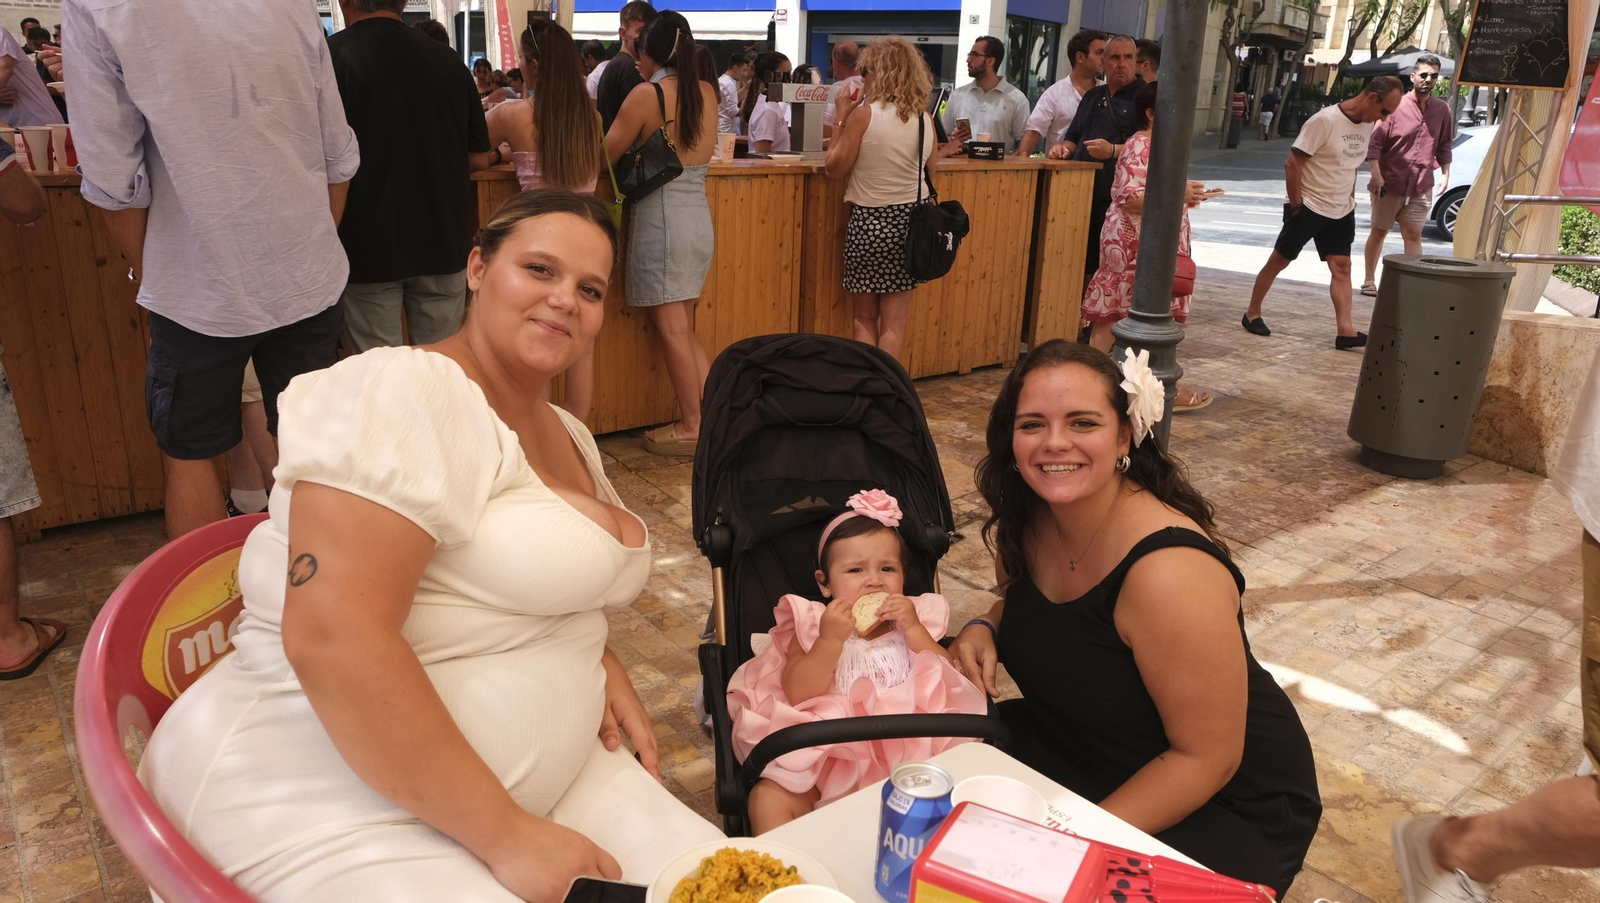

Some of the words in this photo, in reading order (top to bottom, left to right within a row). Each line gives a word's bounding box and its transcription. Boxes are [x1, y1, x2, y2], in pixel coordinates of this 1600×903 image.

[1484, 14, 1505, 23] Lomo
[1480, 26, 1532, 37] Hamburguesa
[892, 791, 904, 802] BAJO
[903, 798, 910, 806] EN
